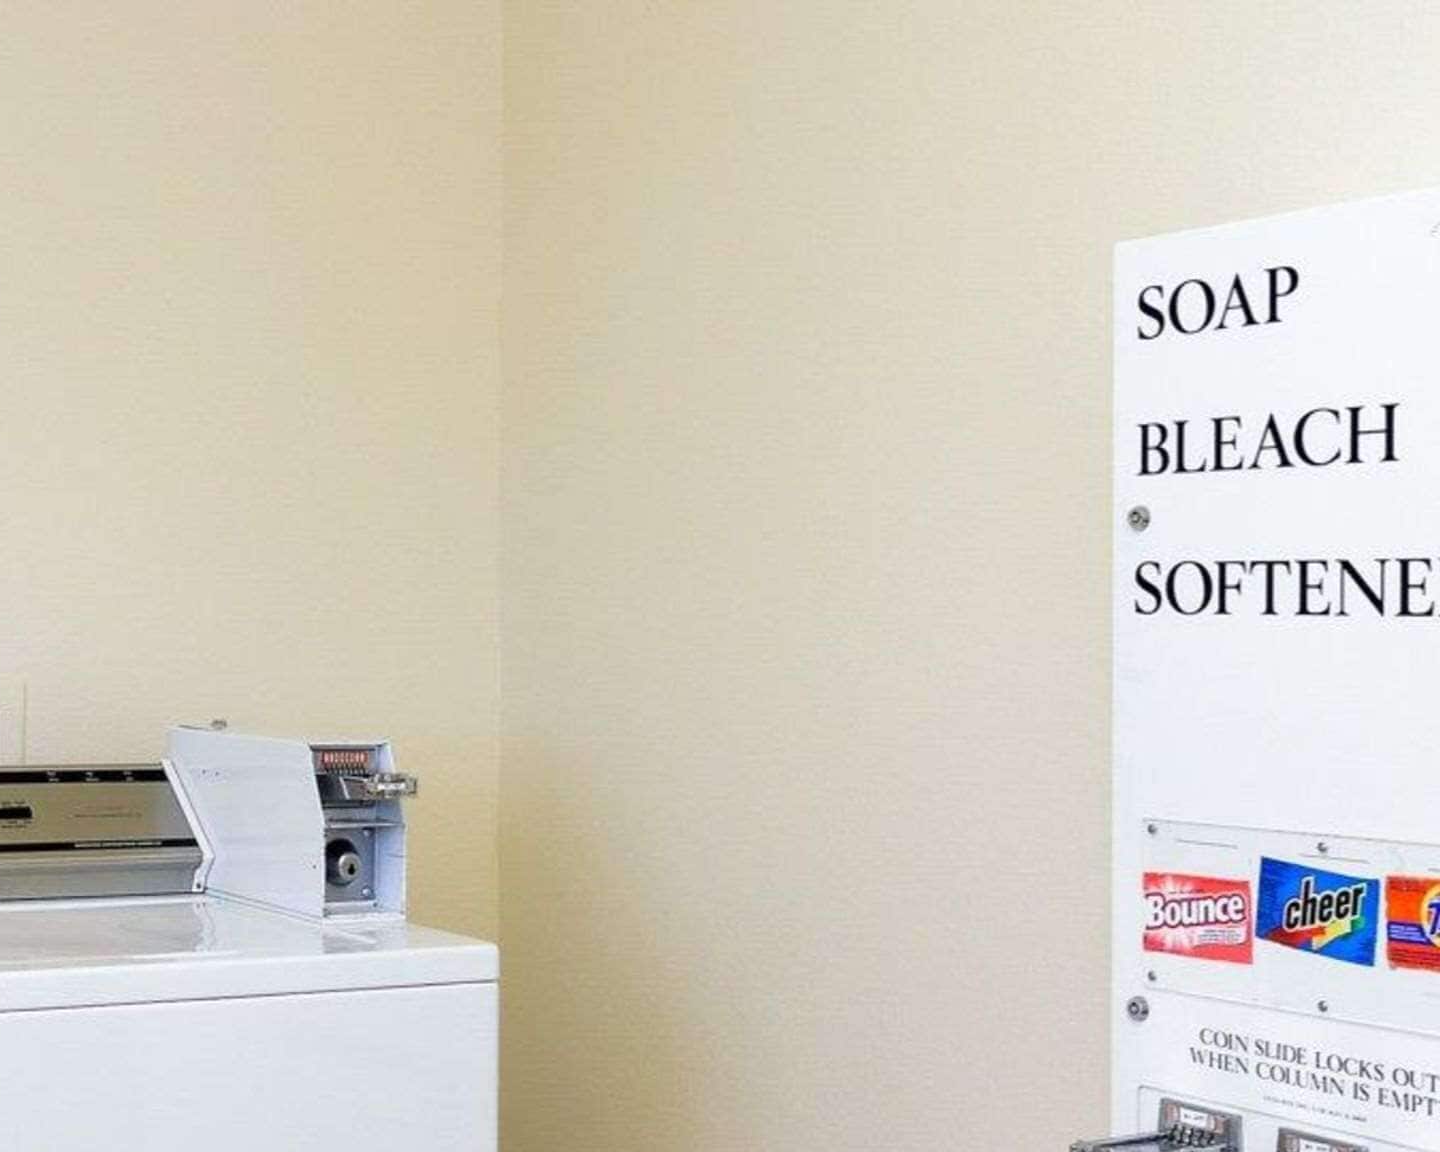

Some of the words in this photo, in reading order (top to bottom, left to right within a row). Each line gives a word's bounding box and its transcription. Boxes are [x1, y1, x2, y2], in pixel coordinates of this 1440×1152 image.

[1137, 265, 1300, 340] SOAP
[1137, 402, 1400, 477] BLEACH
[1134, 557, 1440, 618] SOFTENE
[1143, 891, 1247, 930] Bounce
[1284, 875, 1366, 931] cheer
[1189, 1047, 1250, 1074] WHEN
[1255, 1062, 1346, 1097] COLUMN
[1353, 1082, 1371, 1102] IS
[1378, 1087, 1440, 1116] EMPT
[1199, 1028, 1250, 1052] COIN
[1254, 1039, 1308, 1065] SLIDE
[1315, 1051, 1385, 1082] LOCKS
[1392, 1067, 1440, 1093] OUT
